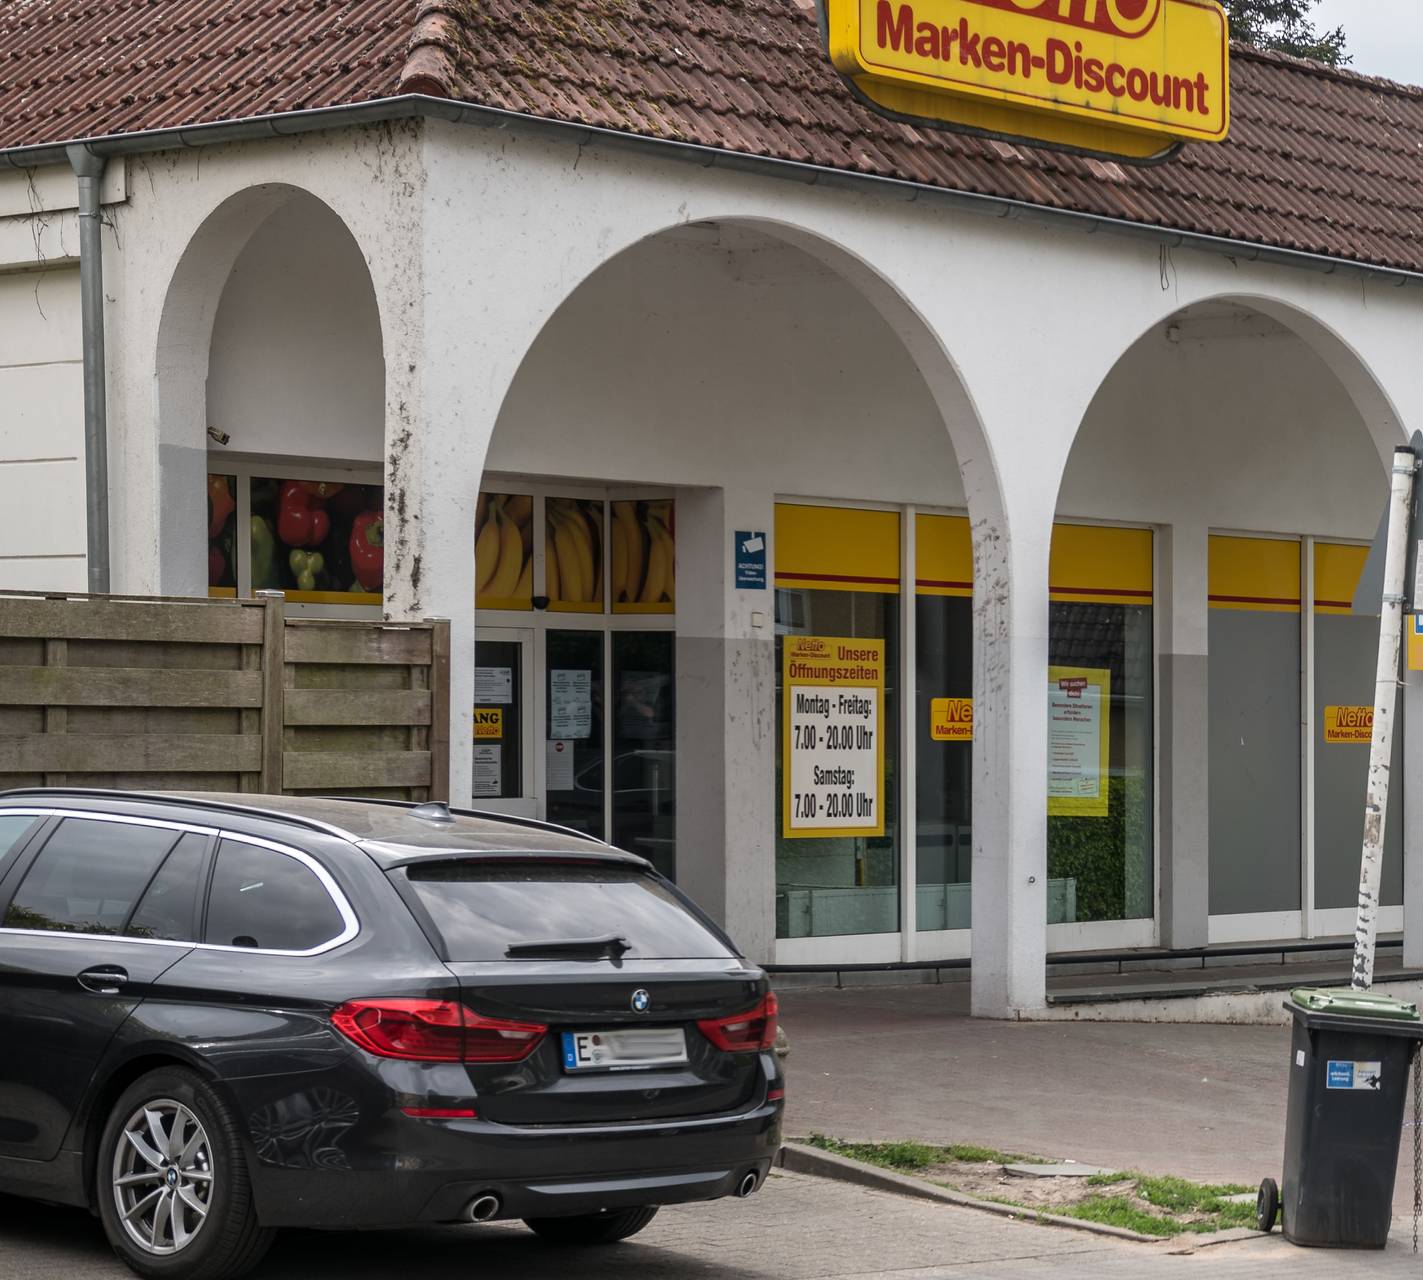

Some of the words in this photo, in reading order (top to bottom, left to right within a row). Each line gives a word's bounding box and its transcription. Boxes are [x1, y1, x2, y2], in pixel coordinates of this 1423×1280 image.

[876, 0, 1209, 115] Marken-Discount
[837, 646, 878, 661] Unsere
[789, 659, 878, 682] Öffnungszeiten
[796, 693, 830, 719] Montag
[838, 694, 872, 719] Freitag:
[946, 699, 973, 722] Ne
[1336, 706, 1374, 727] Netto
[474, 712, 499, 724] ANG
[794, 725, 816, 750] 7.00
[826, 725, 854, 750] 20.00
[856, 725, 873, 750] Uhr
[935, 724, 973, 736] Marken-
[1327, 729, 1372, 739] Marken-Disco
[813, 765, 855, 790] Samstag:
[794, 793, 816, 818] 7.00
[826, 793, 854, 818] 20.00
[856, 792, 873, 818] Uhr
[577, 1036, 591, 1062] E
